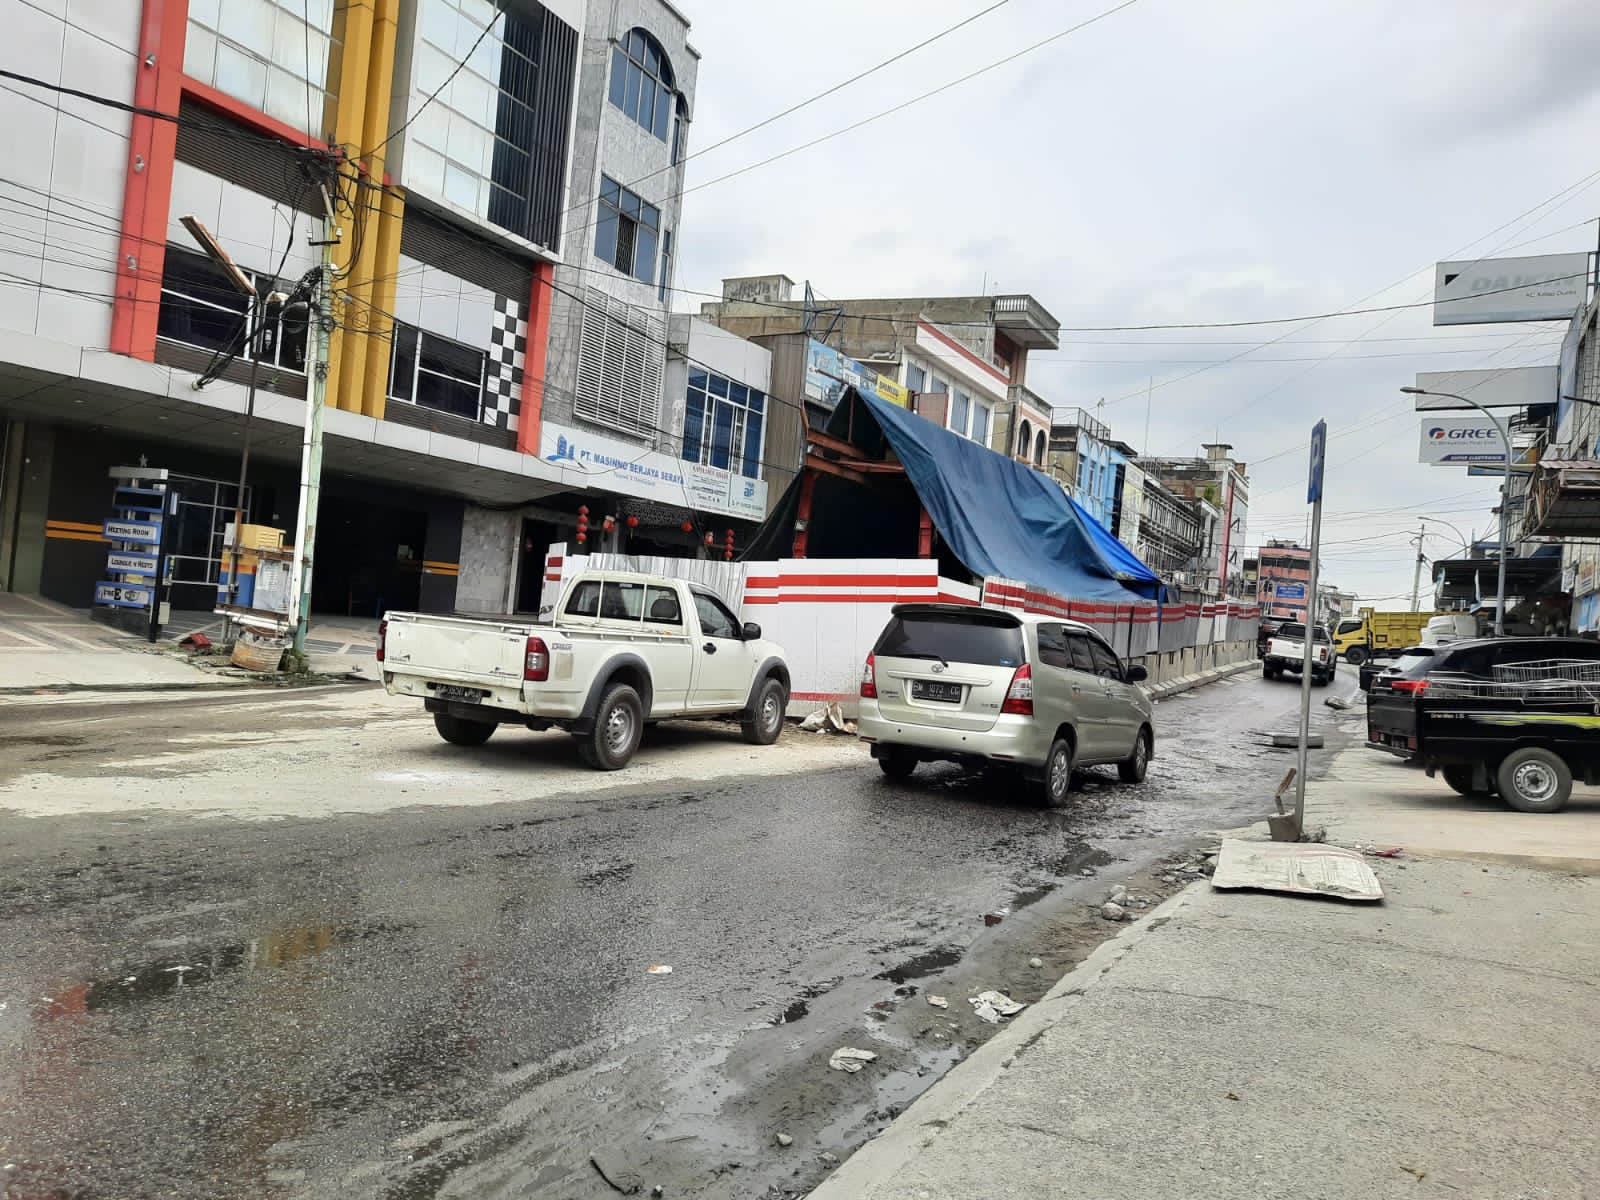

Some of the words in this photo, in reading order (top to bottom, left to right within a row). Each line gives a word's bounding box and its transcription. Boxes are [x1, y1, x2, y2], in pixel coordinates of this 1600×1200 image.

[1448, 428, 1498, 440] GREE
[580, 449, 592, 462] PT.
[629, 463, 660, 479] BERJAYA
[661, 471, 685, 486] SERAYA
[108, 525, 132, 536] MEETING
[132, 528, 150, 537] ROOM
